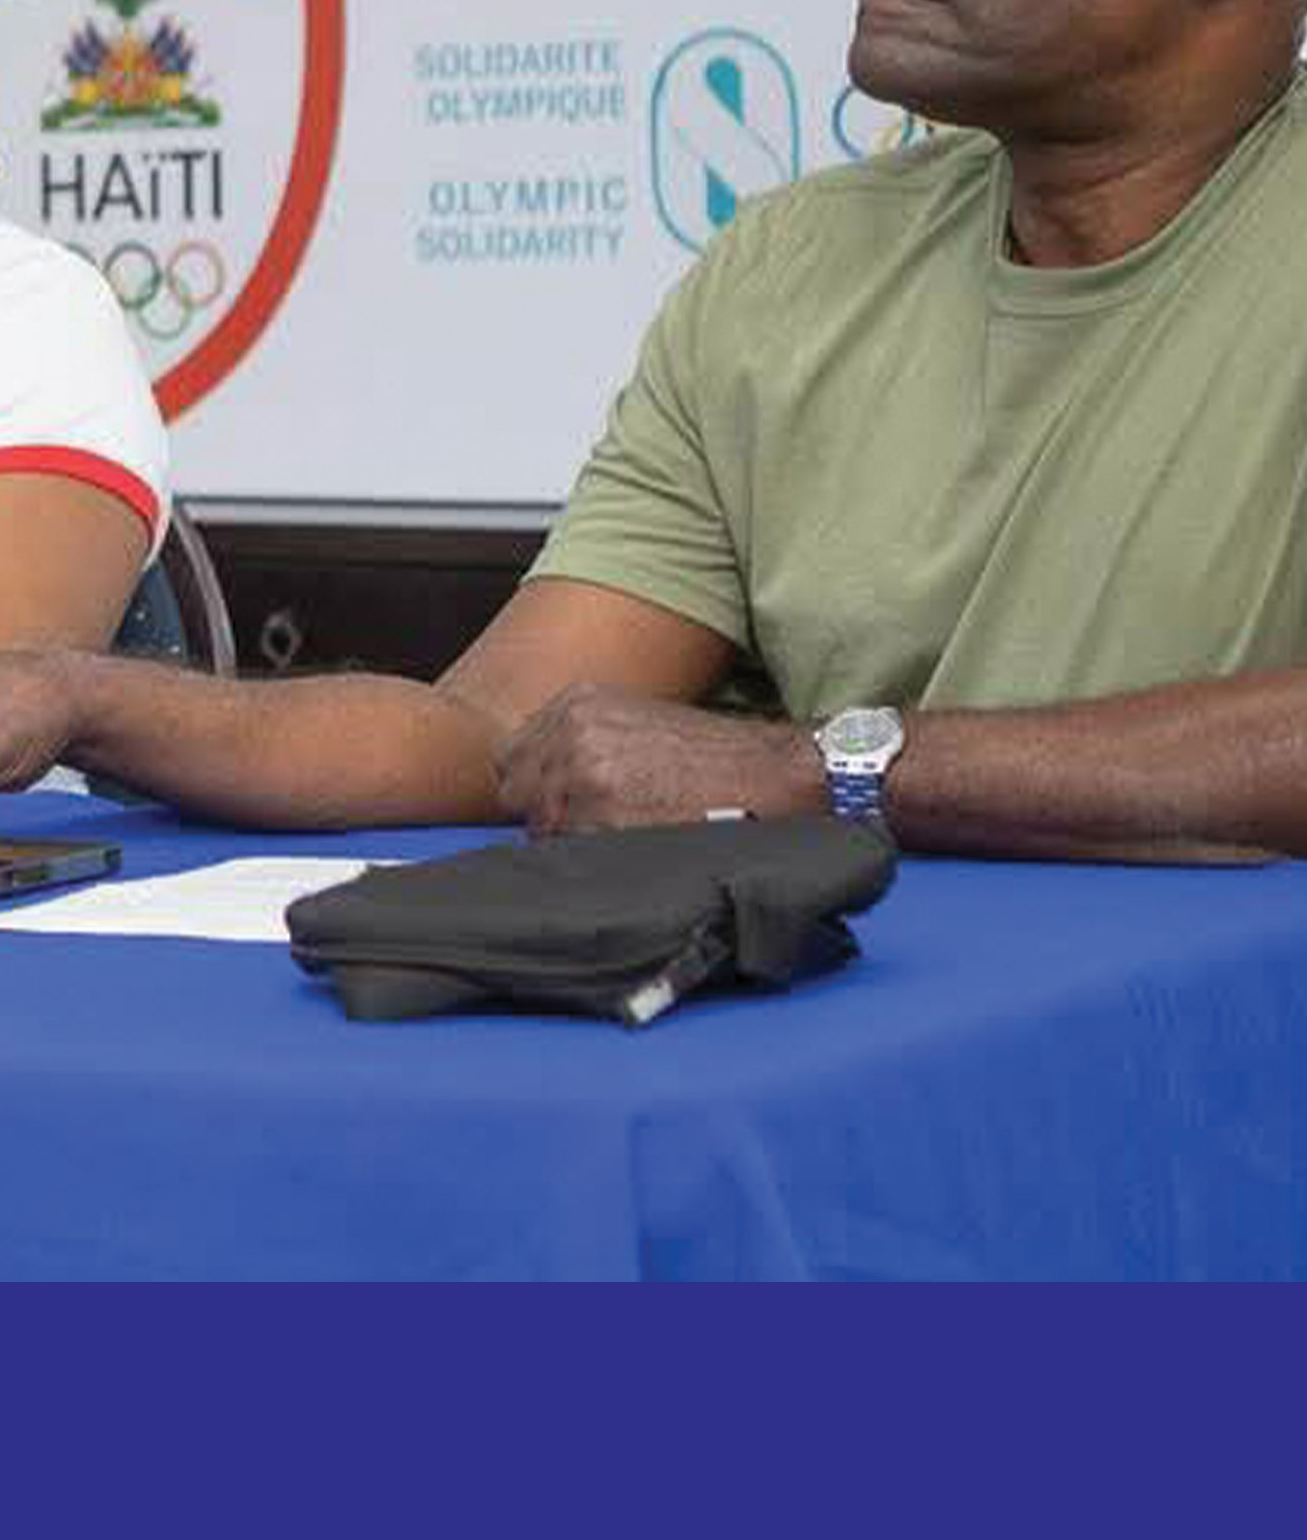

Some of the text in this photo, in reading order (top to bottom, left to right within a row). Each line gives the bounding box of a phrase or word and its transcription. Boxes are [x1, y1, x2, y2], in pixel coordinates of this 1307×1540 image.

[429, 82, 625, 124] OLYMPIQUE
[429, 176, 626, 216] OLYMPIC
[415, 224, 624, 264] SOLIDARITY
